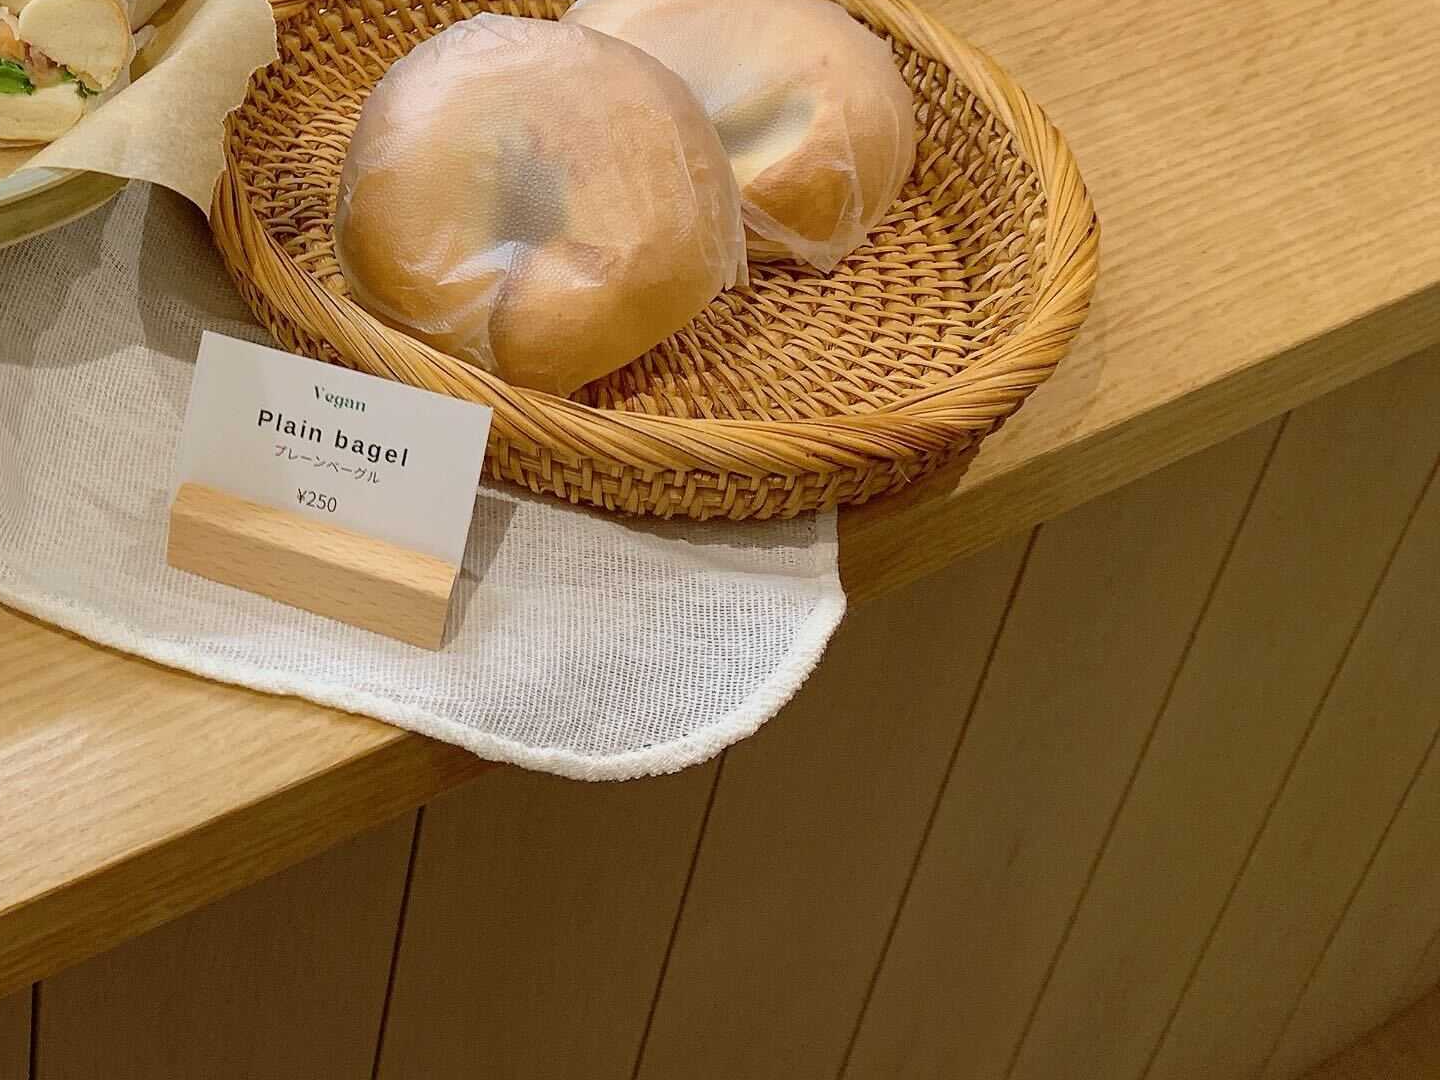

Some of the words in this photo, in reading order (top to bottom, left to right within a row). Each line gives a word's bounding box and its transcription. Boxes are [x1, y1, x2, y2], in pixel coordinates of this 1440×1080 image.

[312, 385, 367, 413] Vegan
[257, 409, 322, 443] Plain
[334, 429, 409, 467] bagel
[297, 488, 338, 513] ¥250
